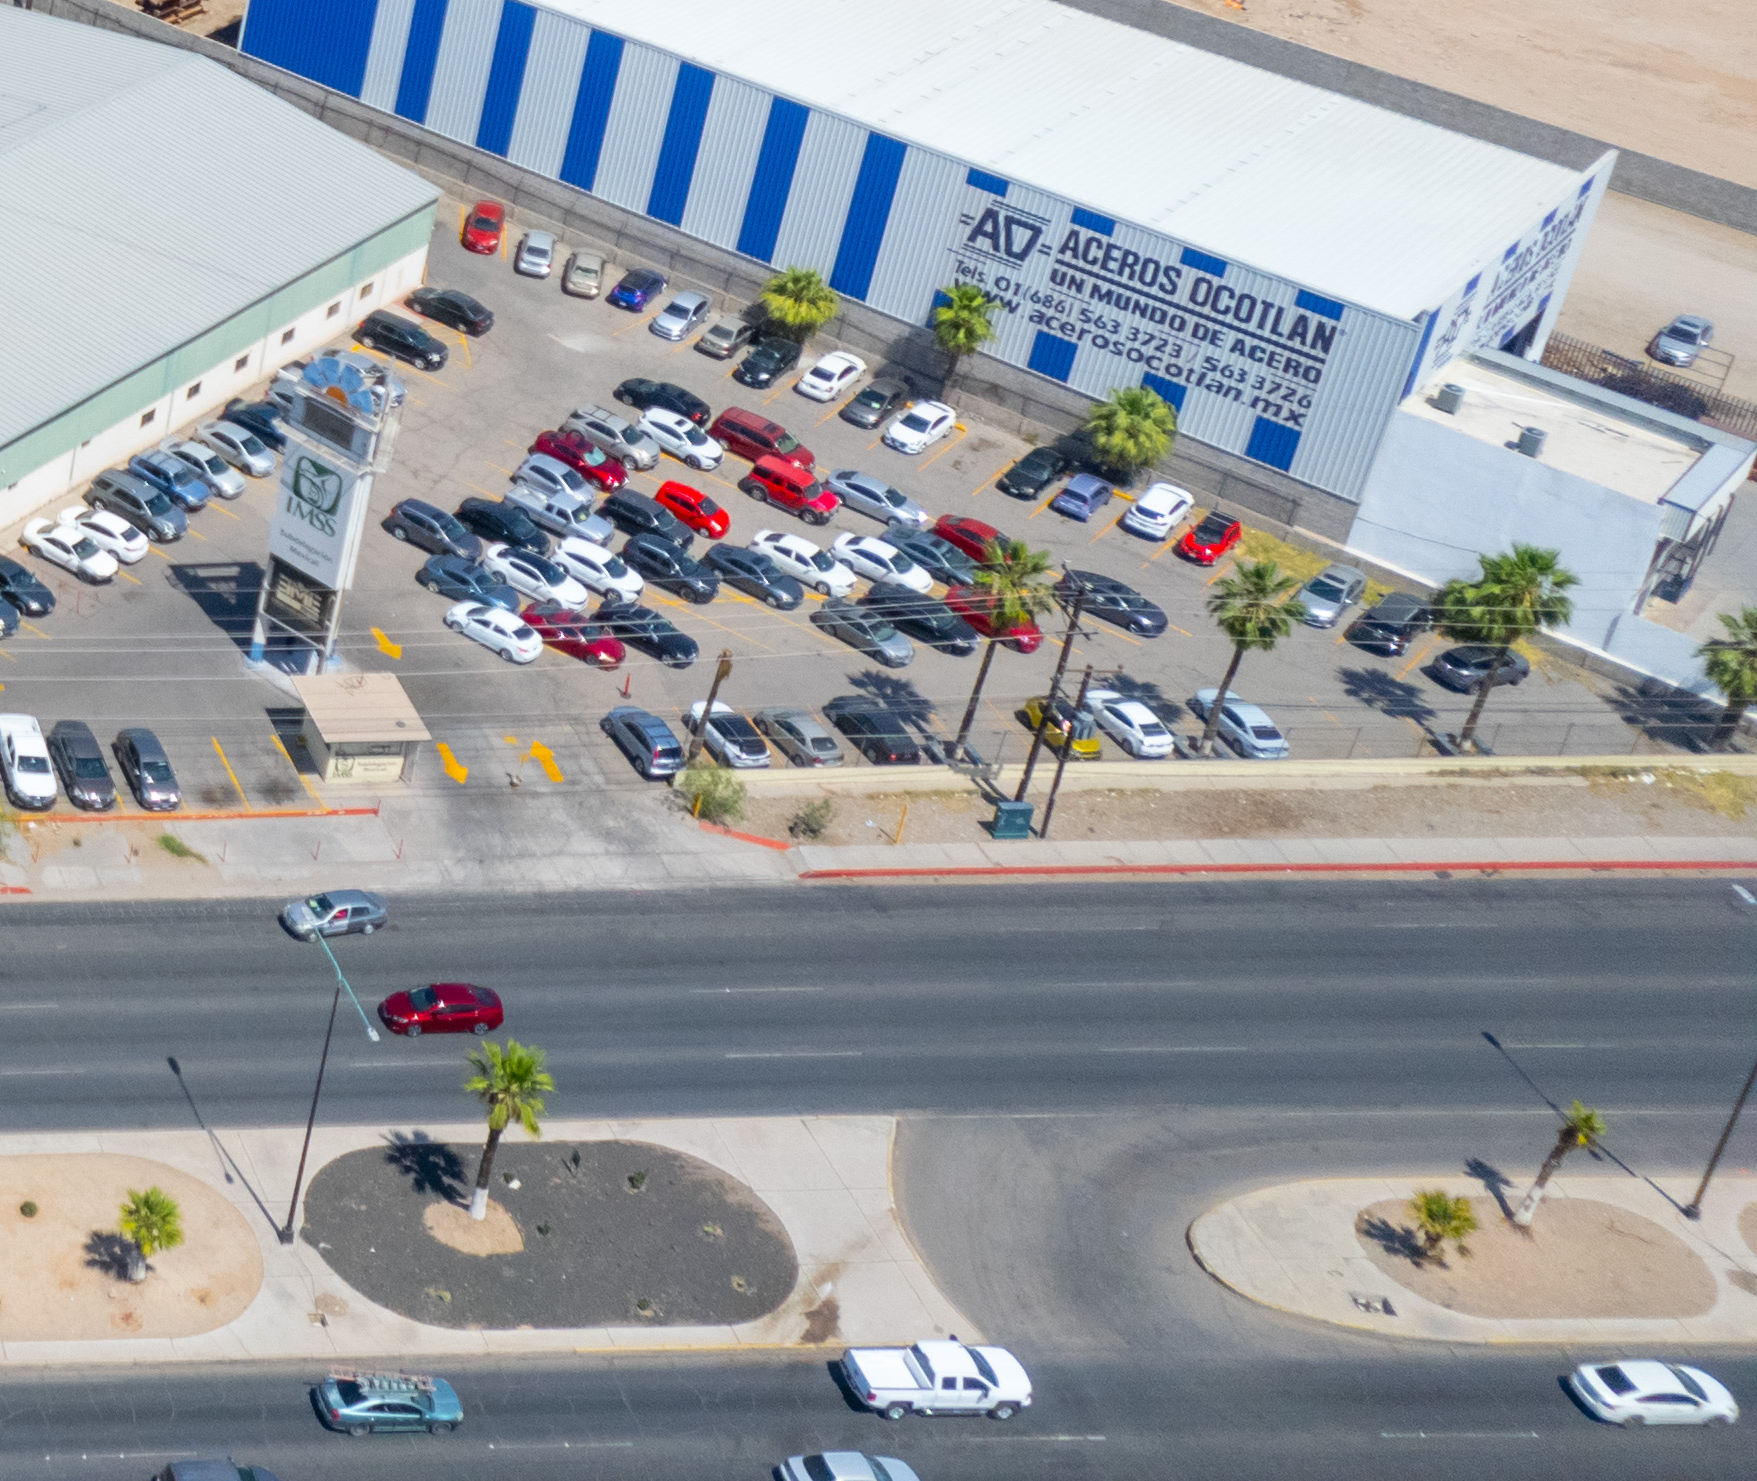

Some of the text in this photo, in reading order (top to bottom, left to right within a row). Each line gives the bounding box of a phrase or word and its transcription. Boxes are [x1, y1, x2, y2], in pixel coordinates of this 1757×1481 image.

[1050, 268, 1322, 385] UN MUNDO DE ACERO
[1058, 228, 1338, 355] ACEROS OCOTLAN
[1078, 307, 1121, 335] 563
[1126, 326, 1183, 360] 3723
[1201, 355, 1248, 384] 563
[1251, 374, 1313, 409] 3726
[285, 495, 337, 538] IMSS
